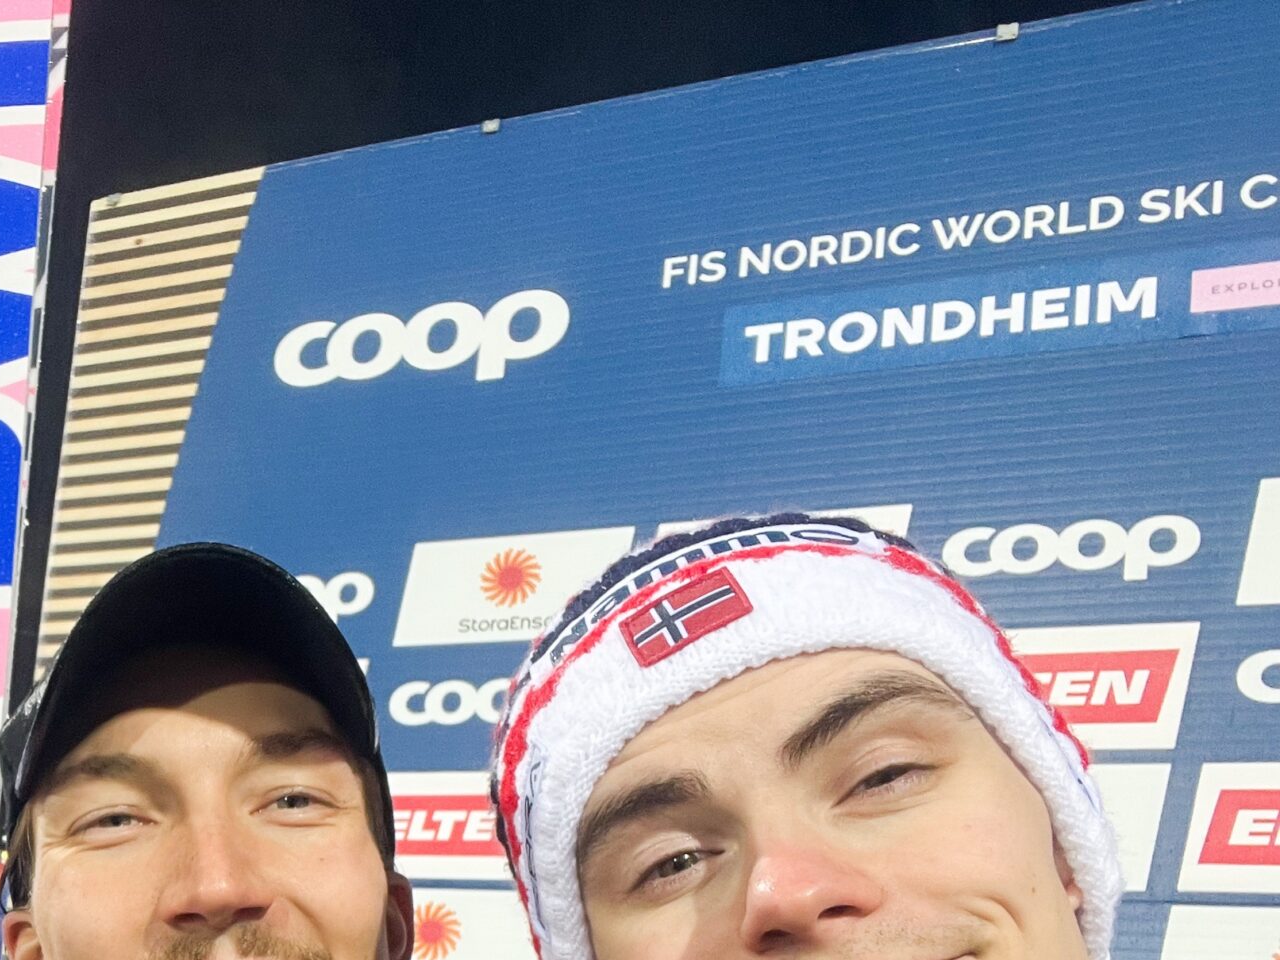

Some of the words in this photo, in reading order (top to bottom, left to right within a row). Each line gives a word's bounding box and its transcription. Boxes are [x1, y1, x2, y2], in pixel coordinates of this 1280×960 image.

[661, 250, 727, 289] FIS
[738, 223, 921, 278] NORDIC
[932, 195, 1125, 252] WORLD
[1137, 180, 1224, 225] SKI
[273, 288, 571, 388] coop
[744, 276, 1160, 364] TRONDHEIM
[942, 515, 1202, 581] coop
[389, 678, 510, 727] coo
[394, 810, 497, 841] ELTE
